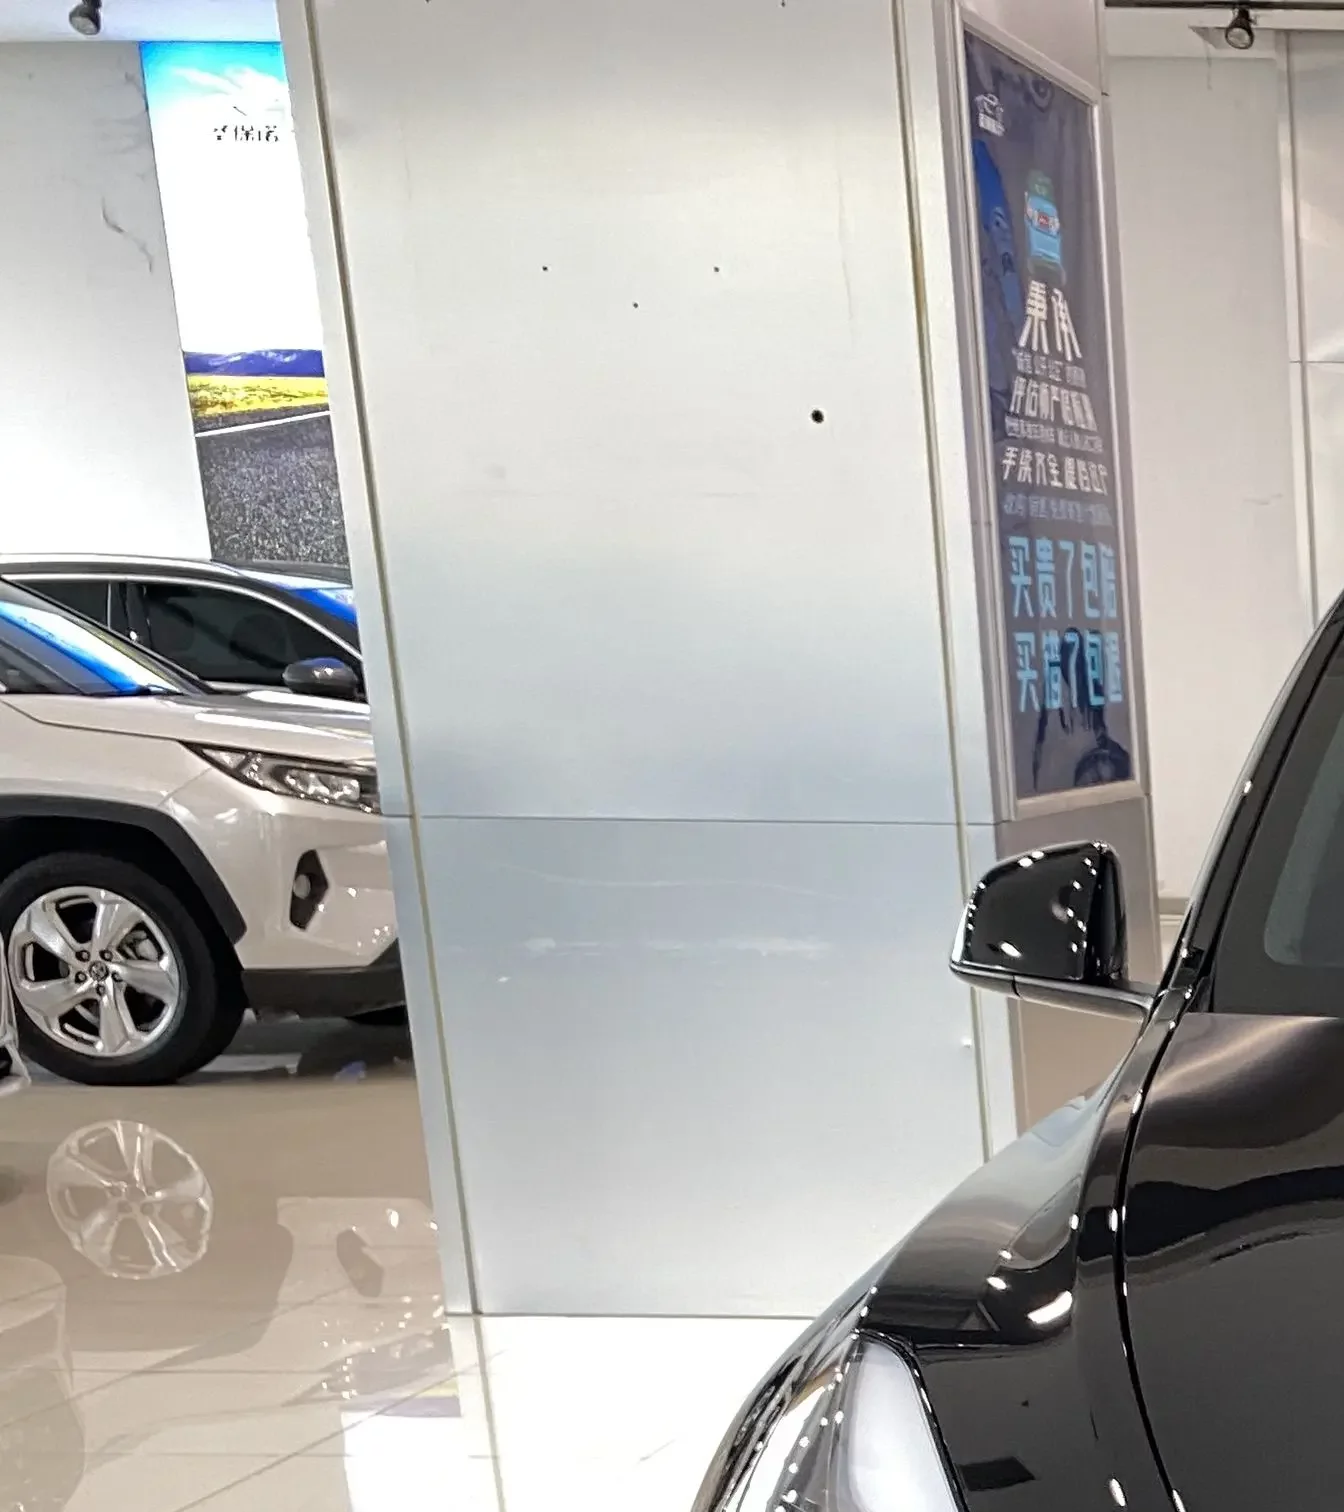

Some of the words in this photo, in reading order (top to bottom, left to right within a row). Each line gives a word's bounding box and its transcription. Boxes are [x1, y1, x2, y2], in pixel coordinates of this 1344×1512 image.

[1018, 280, 1083, 362] 秉承
[1008, 535, 1118, 619] 买贵了包赔
